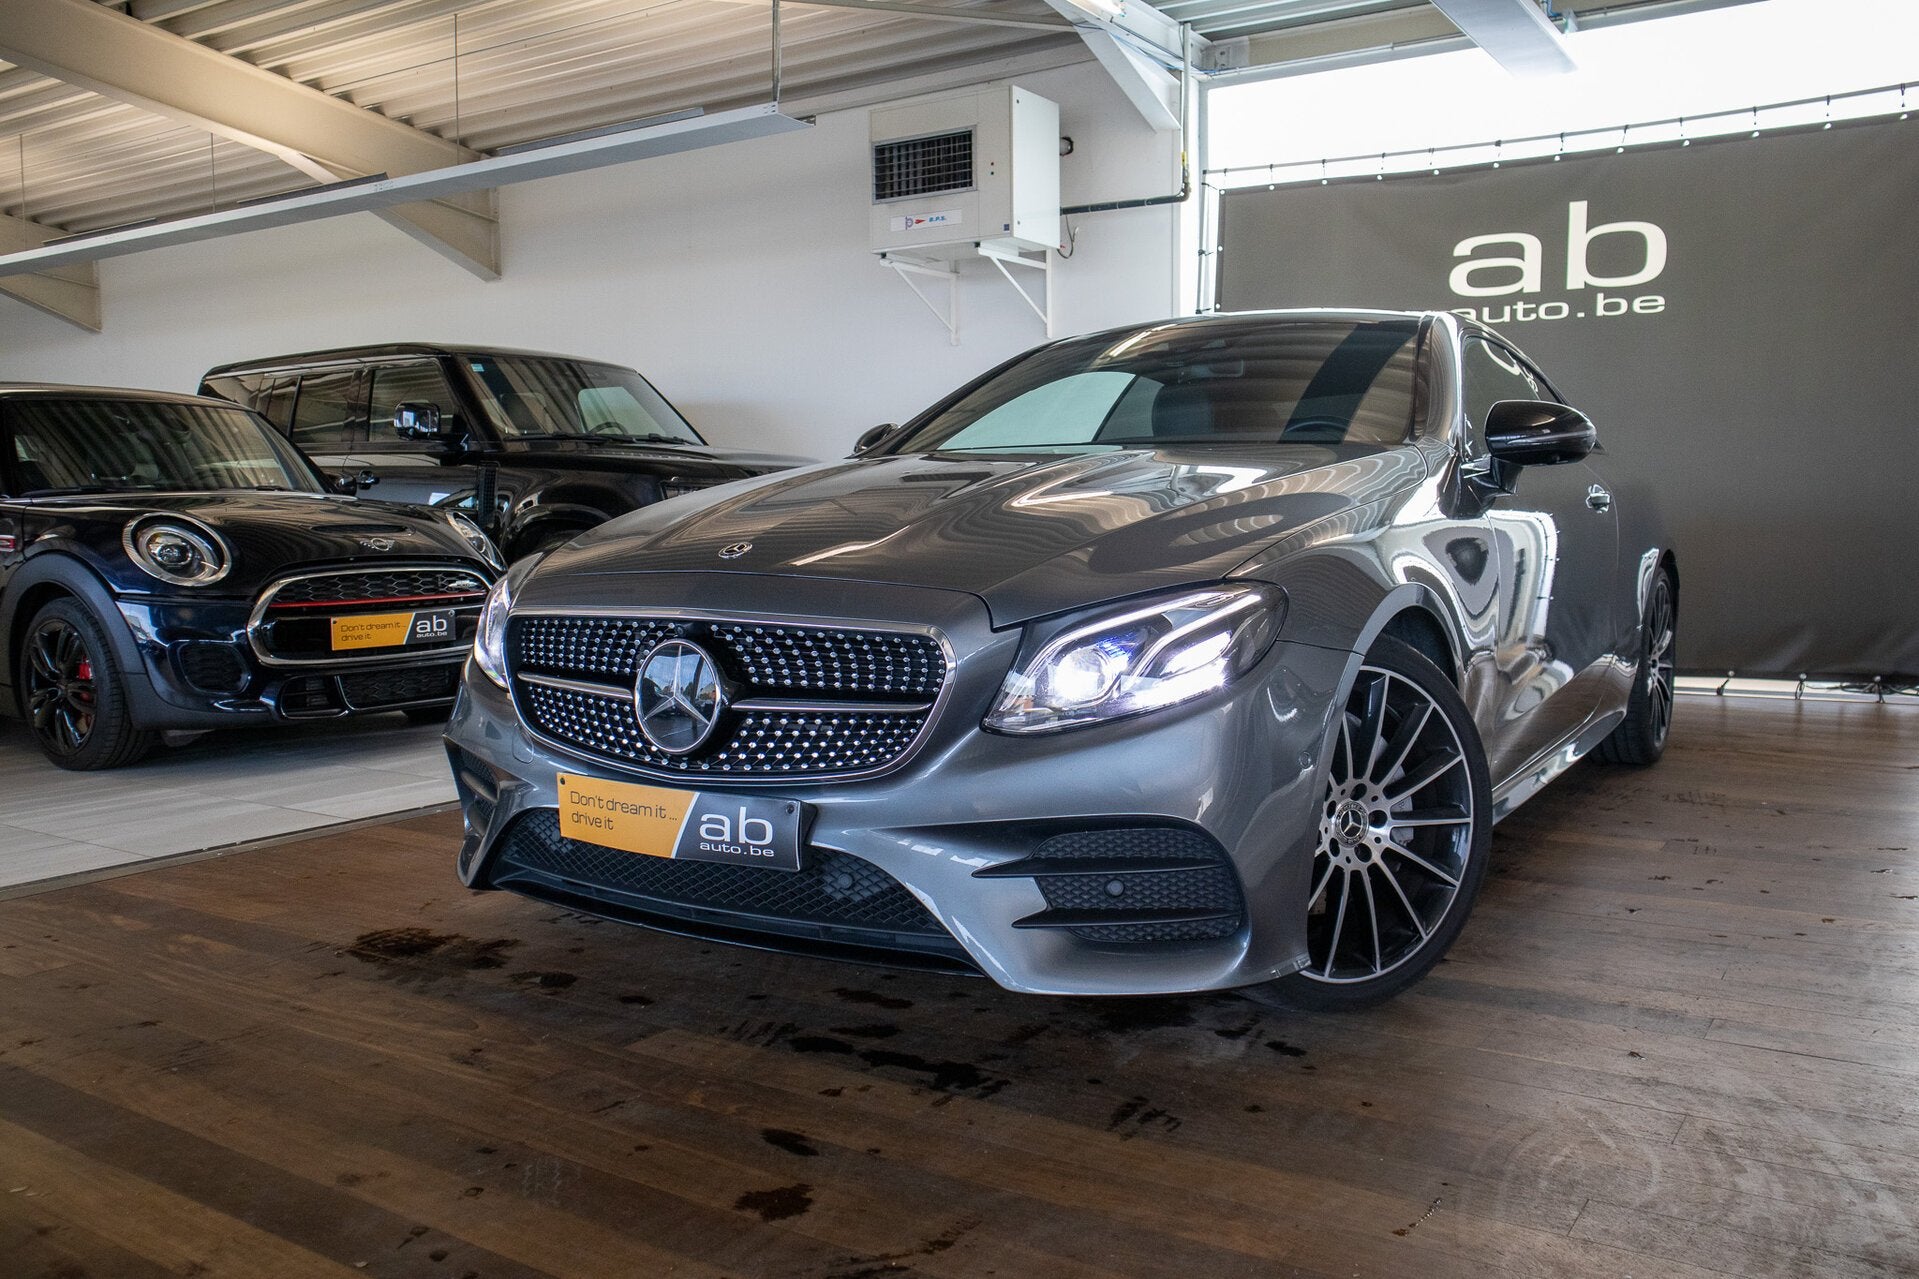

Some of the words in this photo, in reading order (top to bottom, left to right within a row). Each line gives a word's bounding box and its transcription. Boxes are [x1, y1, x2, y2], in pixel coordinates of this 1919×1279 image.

[1449, 200, 1668, 297] ab
[341, 623, 365, 633] Don't
[366, 621, 393, 631] dream
[416, 615, 448, 633] ab
[341, 633, 364, 641] drive
[365, 632, 372, 640] it
[570, 790, 605, 810] Don't
[606, 798, 653, 818] dream
[571, 811, 603, 829] drive
[604, 816, 614, 831] it
[699, 806, 773, 846] ab
[699, 842, 775, 857] auto.be
